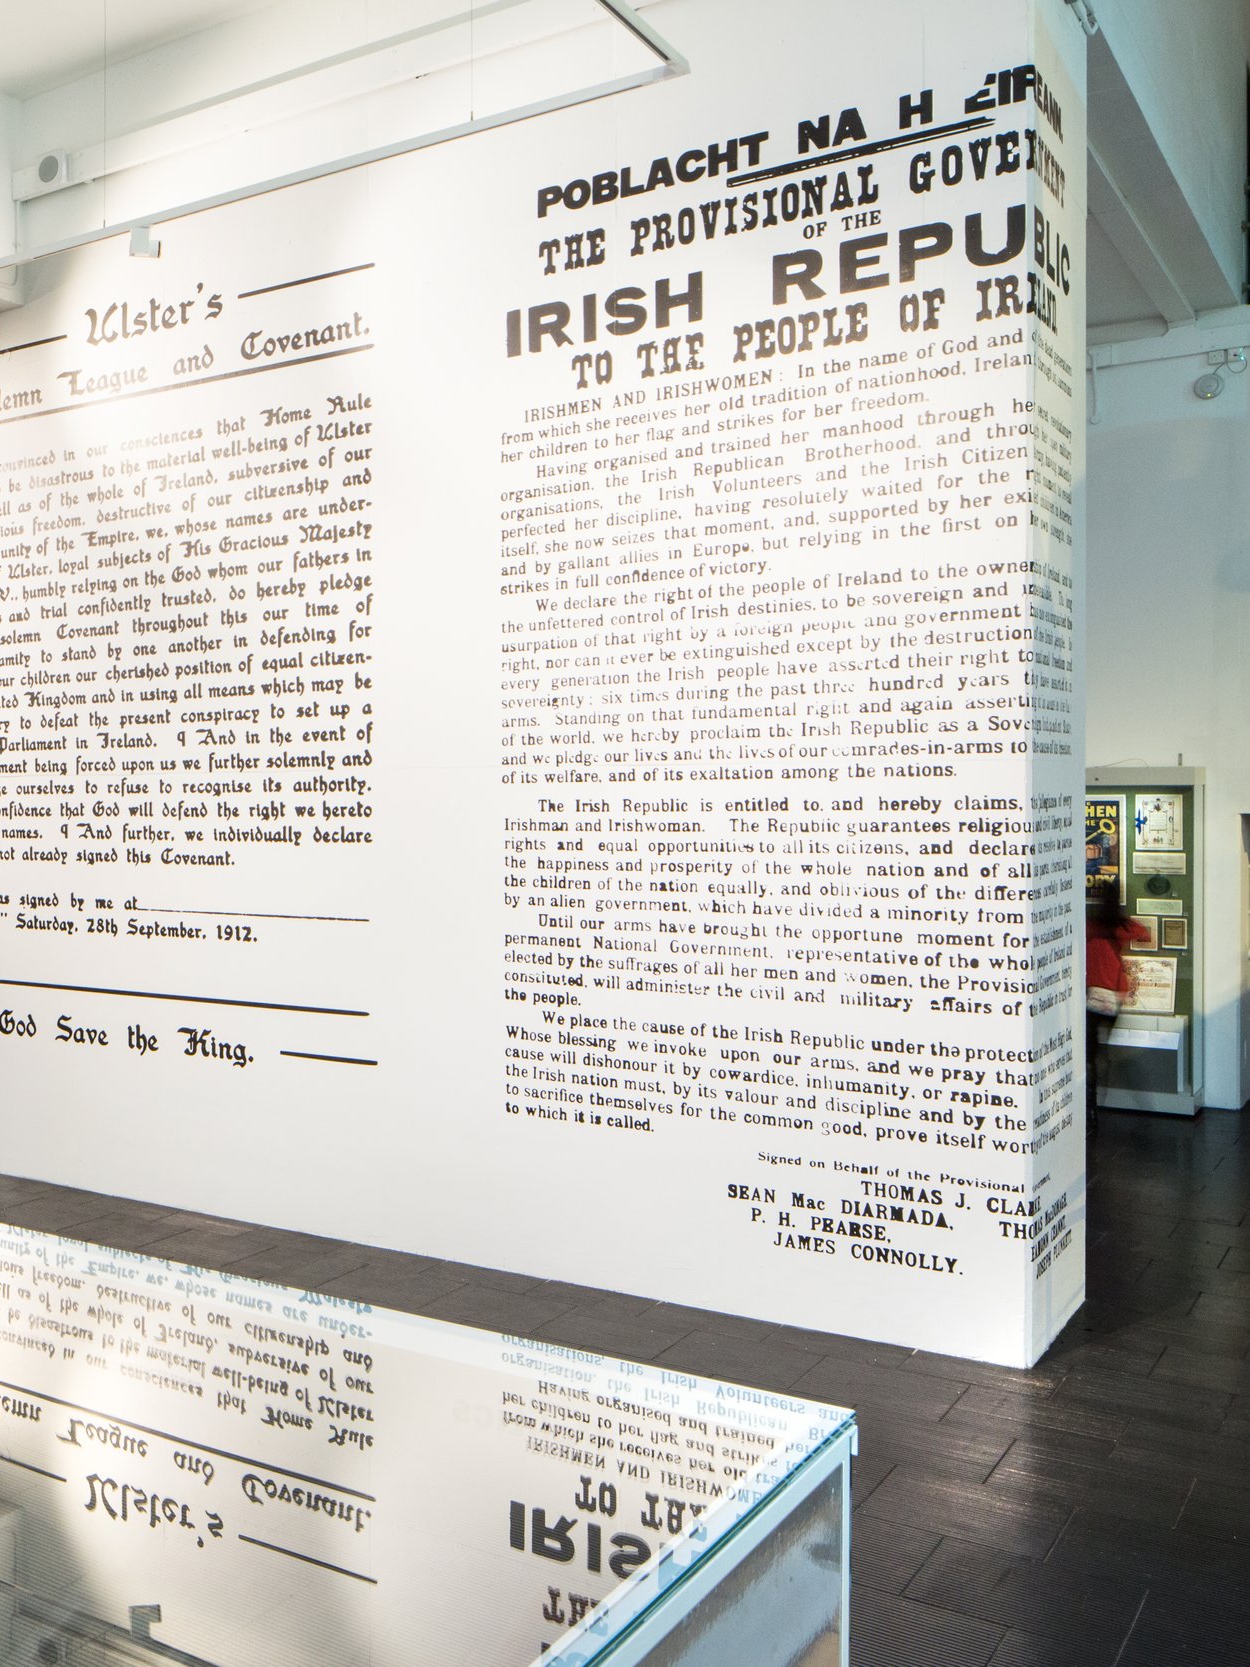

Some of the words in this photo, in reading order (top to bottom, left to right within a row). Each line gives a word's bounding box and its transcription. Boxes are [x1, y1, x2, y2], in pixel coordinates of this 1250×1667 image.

[537, 131, 769, 218] POBLACHT
[798, 108, 867, 154] NA
[899, 90, 934, 129] H
[539, 227, 606, 276] THE
[630, 165, 880, 256] PROVISIONAL
[803, 220, 828, 241] OF
[841, 210, 882, 232] THE
[506, 271, 704, 359] IRISH
[772, 204, 1070, 305] REPUBLIC
[85, 283, 223, 346] Ulster's
[572, 347, 612, 390] TO
[637, 333, 705, 377] THE
[733, 302, 868, 363] PEOPLE
[899, 287, 945, 333] OF
[56, 367, 148, 398] League
[173, 345, 214, 376] and
[240, 312, 370, 361] Covenant.
[524, 398, 602, 423] IRISHMEN
[612, 391, 646, 408] AND
[798, 364, 815, 379] In
[823, 358, 851, 375] the
[859, 352, 909, 369] name
[916, 343, 935, 361] of
[942, 336, 978, 355] God
[987, 329, 1023, 348] and
[22, 849, 68, 865] already
[76, 849, 119, 866] signed
[126, 849, 151, 865] this
[161, 850, 235, 867] Covenant.
[86, 918, 118, 937] 28th
[216, 925, 258, 942] 1912.
[55, 1015, 109, 1045] Save
[127, 1025, 159, 1055] the
[177, 1027, 254, 1068] King.
[758, 1152, 802, 1166] Signed
[810, 1160, 825, 1169] on
[833, 1160, 879, 1177] Behalf
[887, 1167, 900, 1178] of
[908, 1170, 931, 1183] the
[940, 1173, 1025, 1194] Provisional
[860, 1180, 943, 1206] THOMAS
[955, 1193, 972, 1211] J.
[727, 1183, 776, 1203] SEAN
[791, 1192, 826, 1211] Mac
[841, 1199, 954, 1231] DIARMADA,
[751, 1208, 766, 1224] P.
[778, 1212, 796, 1229] H.
[811, 1216, 892, 1243] PEARSE,
[774, 1232, 836, 1255] JAMES
[851, 1244, 964, 1275] CONNOLLY.
